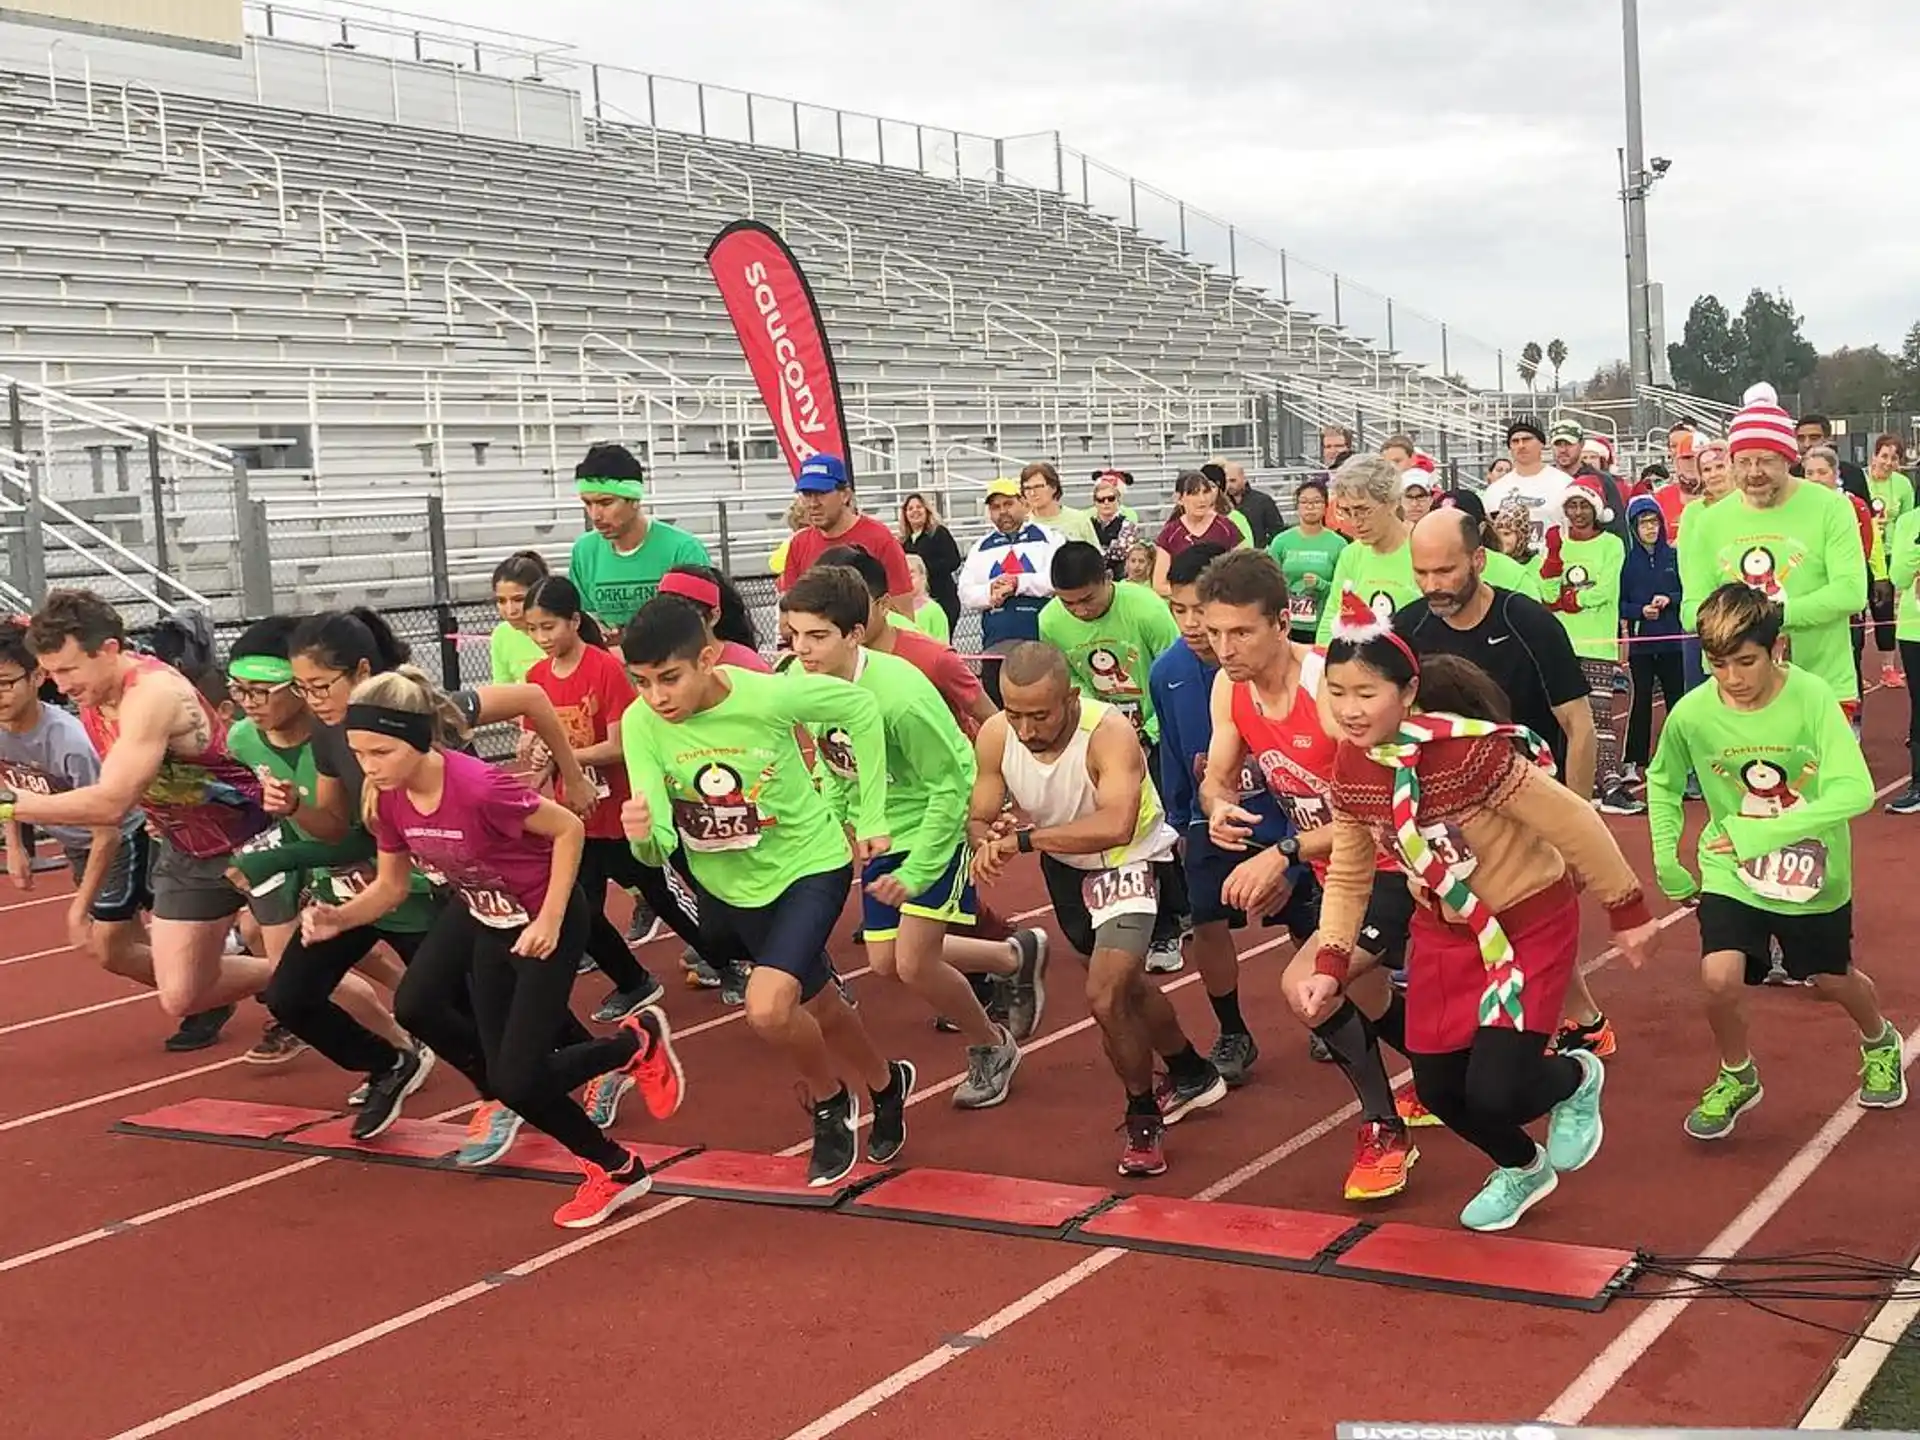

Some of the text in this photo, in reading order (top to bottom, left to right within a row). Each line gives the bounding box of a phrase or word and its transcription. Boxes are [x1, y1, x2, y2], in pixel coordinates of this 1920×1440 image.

[744, 261, 826, 434] saucony
[595, 585, 657, 602] OAKLAN
[1753, 850, 1815, 886] 199
